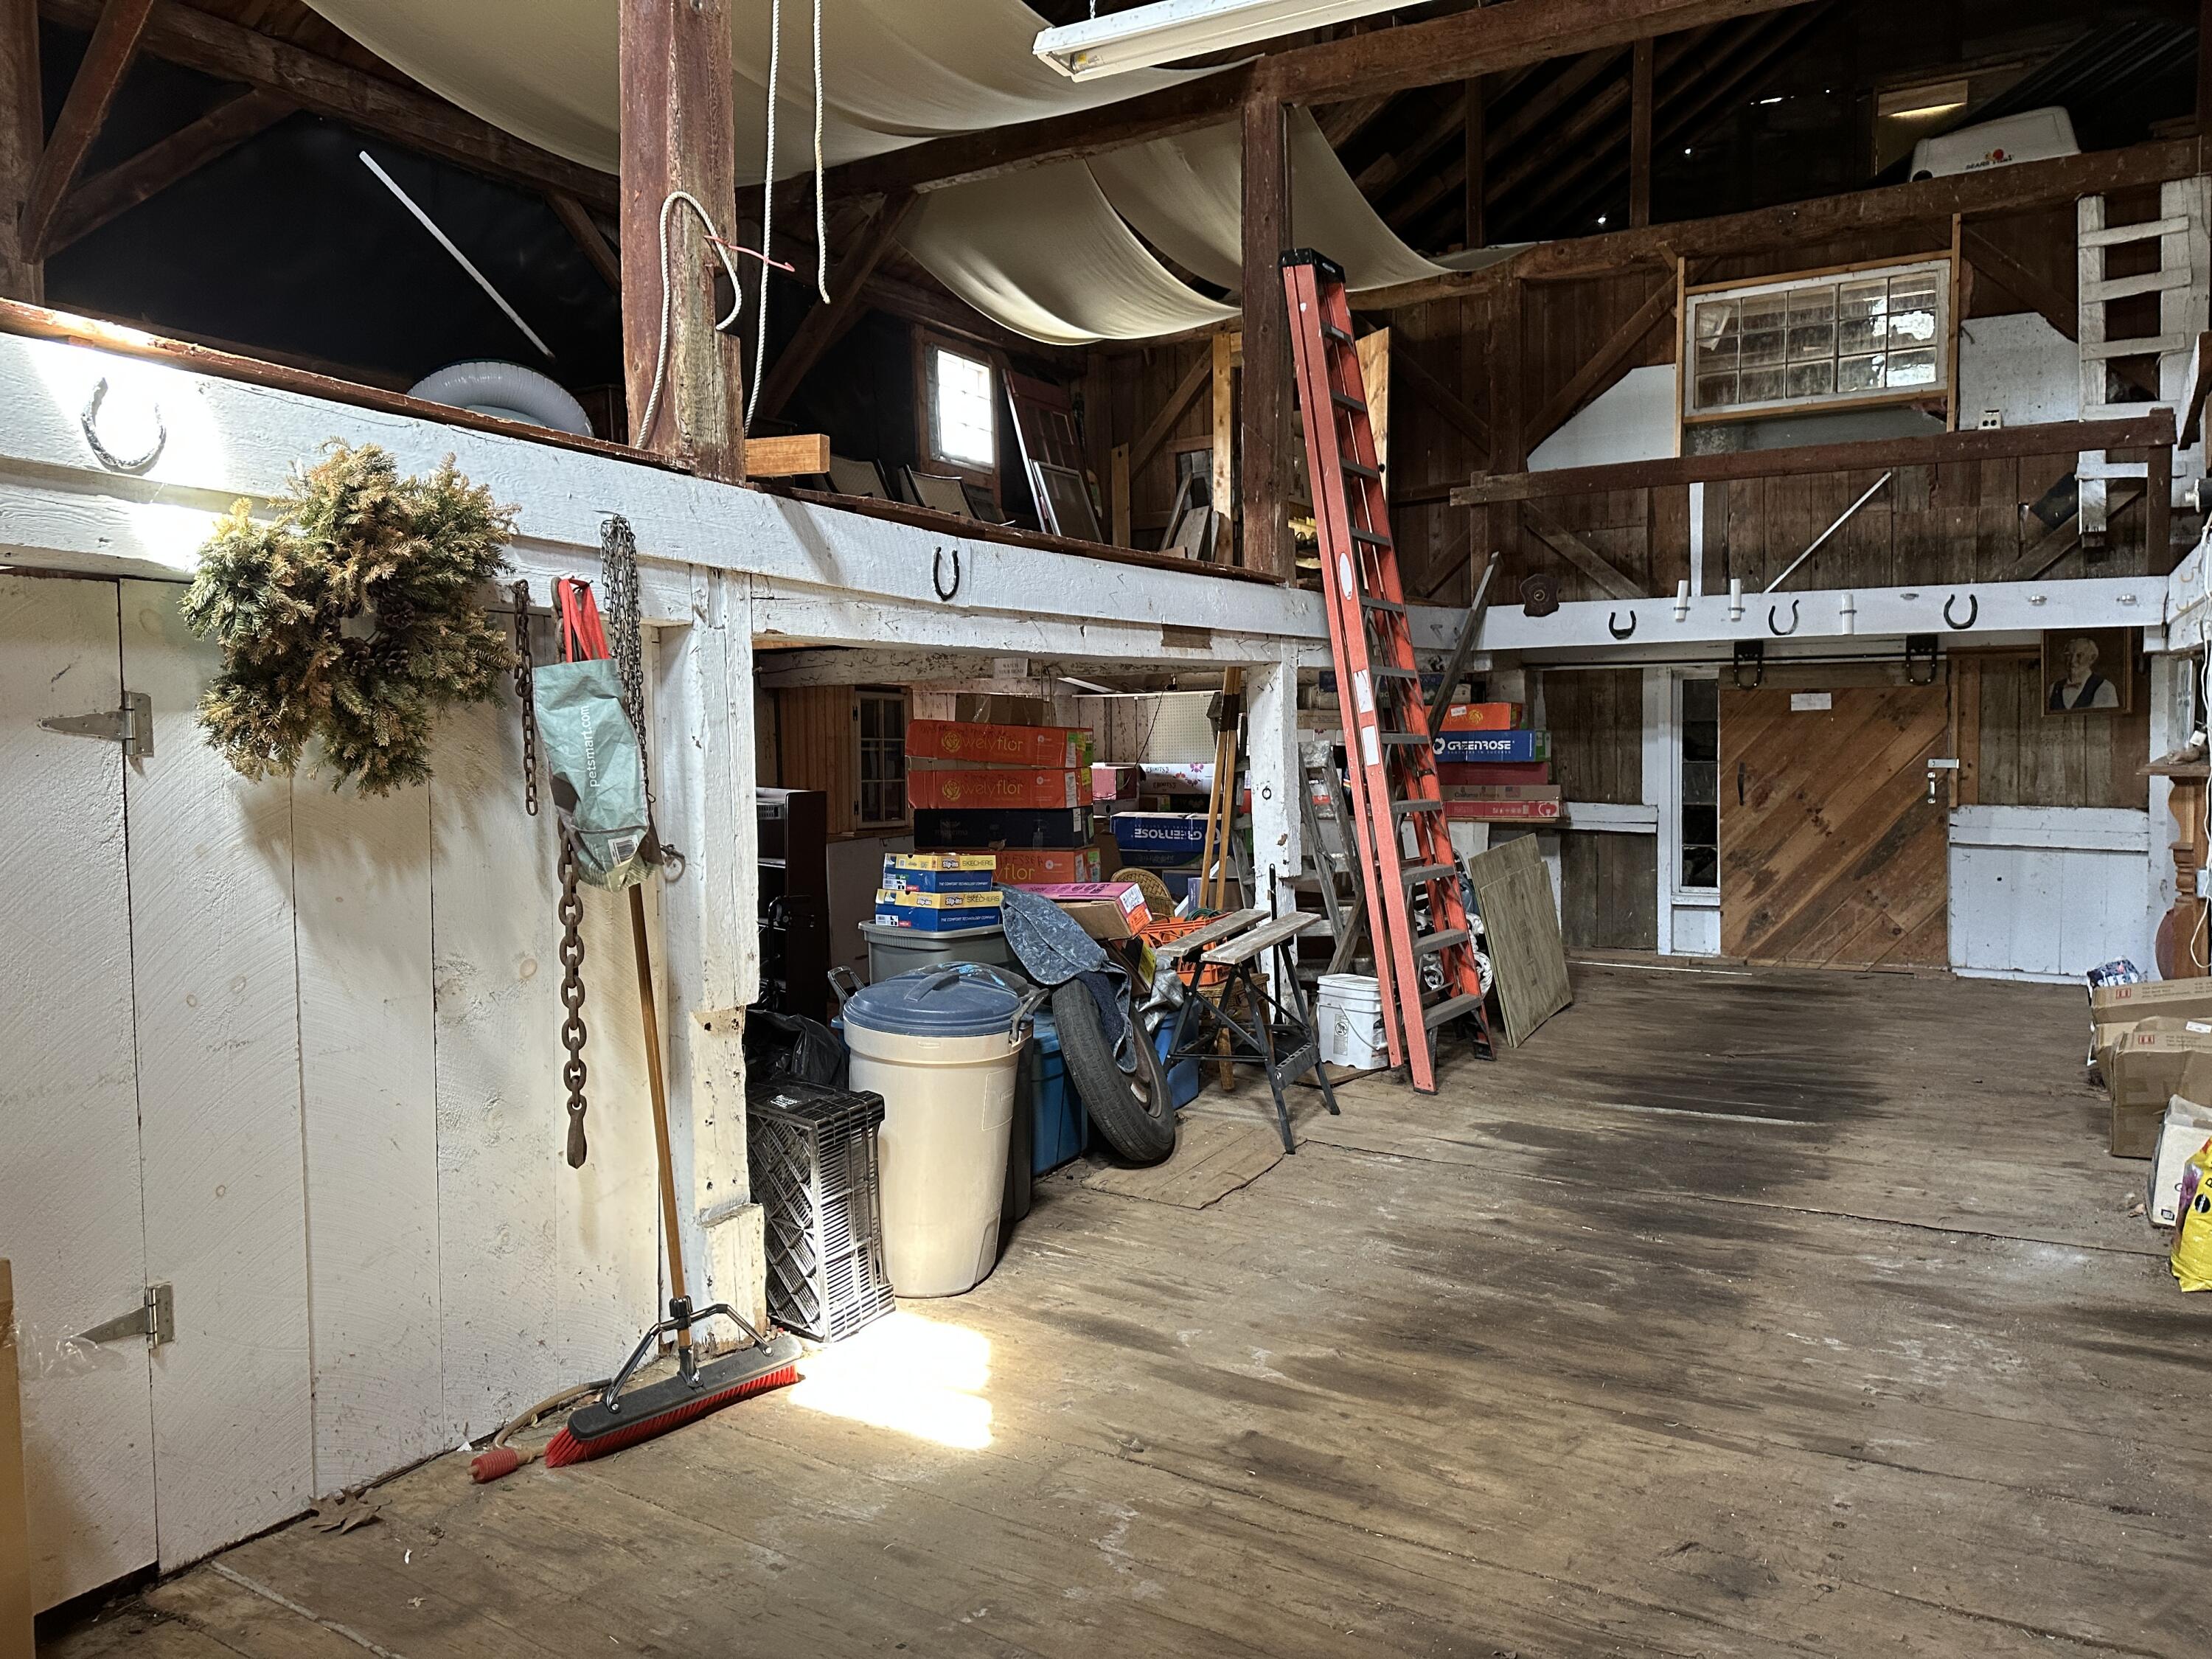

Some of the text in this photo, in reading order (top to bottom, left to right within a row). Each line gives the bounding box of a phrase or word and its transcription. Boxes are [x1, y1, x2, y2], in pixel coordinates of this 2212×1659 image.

[580, 705, 600, 787] petsmart.com
[961, 737, 1023, 752] welyflor
[1447, 740, 1512, 751] GREENROSE
[961, 779, 1023, 797] welyflor
[1134, 829, 1203, 840] GREENROSE
[994, 863, 1035, 882] yflor
